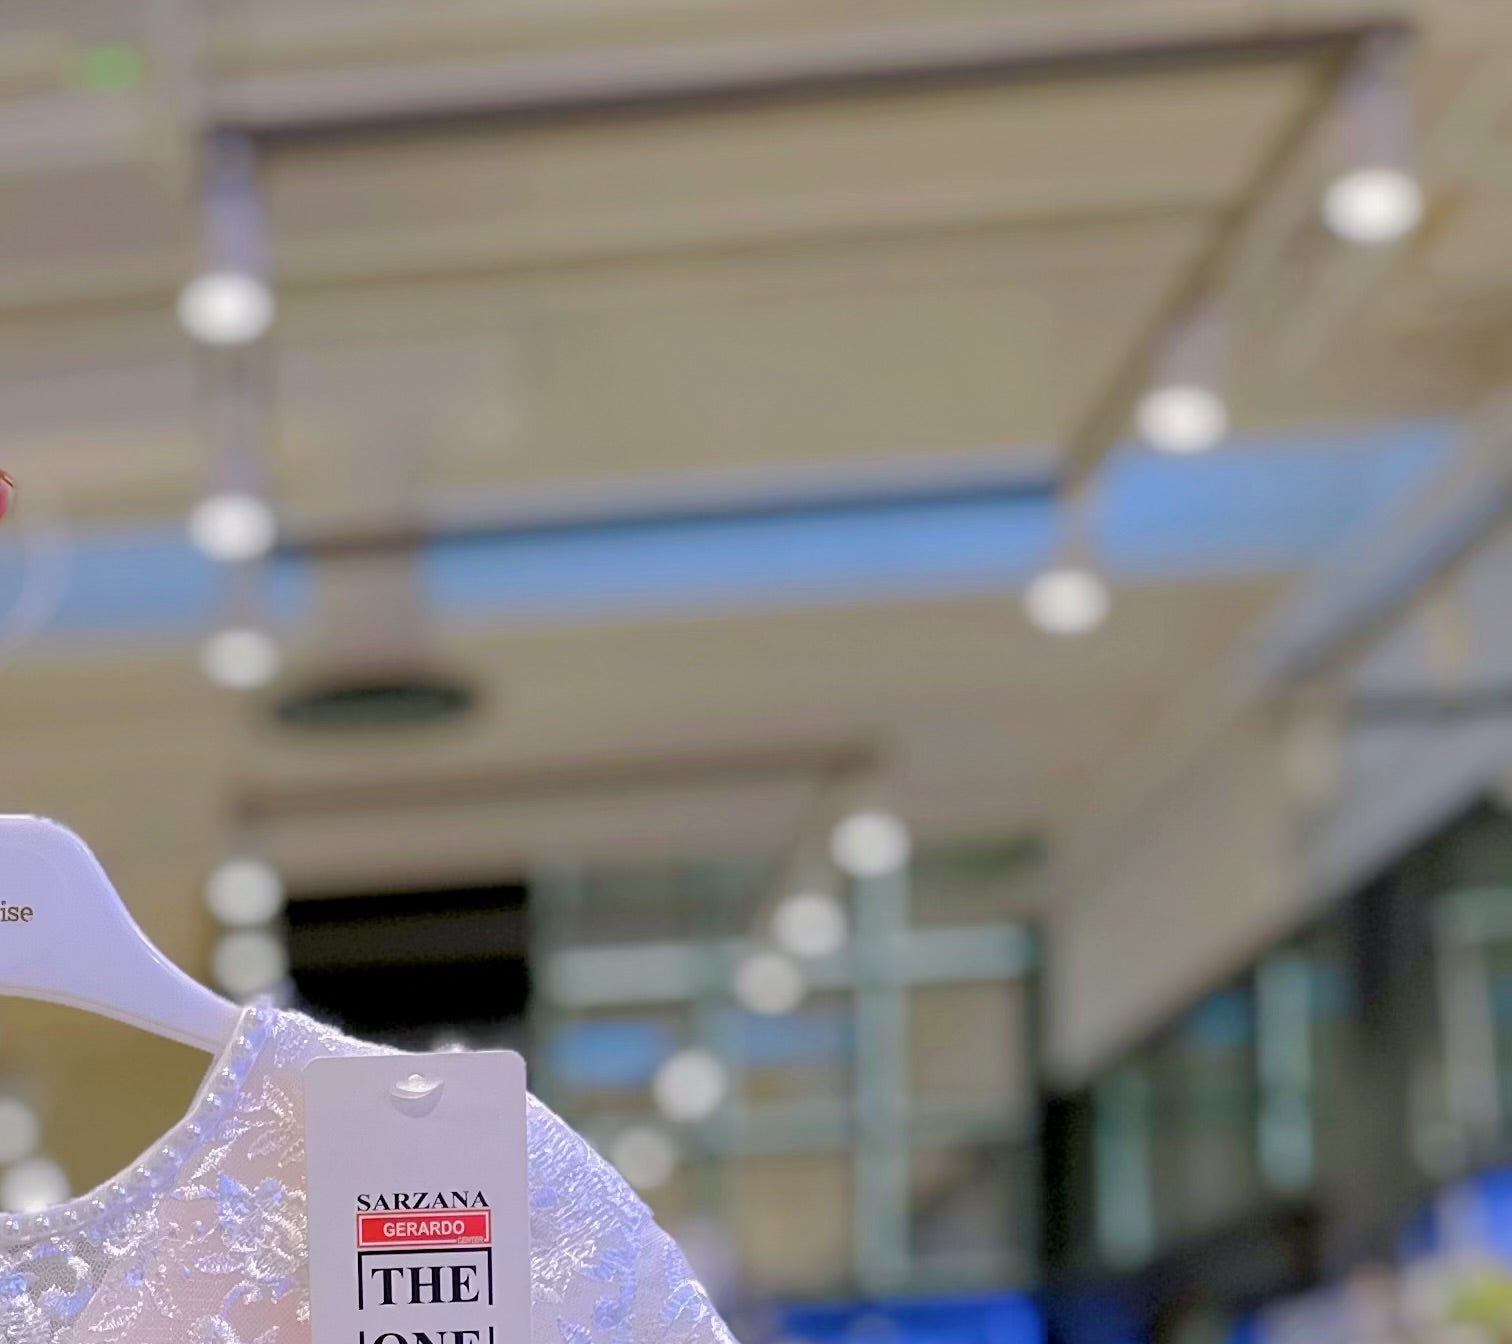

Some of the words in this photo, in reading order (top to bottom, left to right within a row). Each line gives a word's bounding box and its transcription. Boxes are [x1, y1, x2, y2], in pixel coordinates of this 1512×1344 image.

[357, 1190, 489, 1212] SARZANA
[383, 1220, 465, 1238] GERARDO
[371, 1265, 480, 1306] THE
